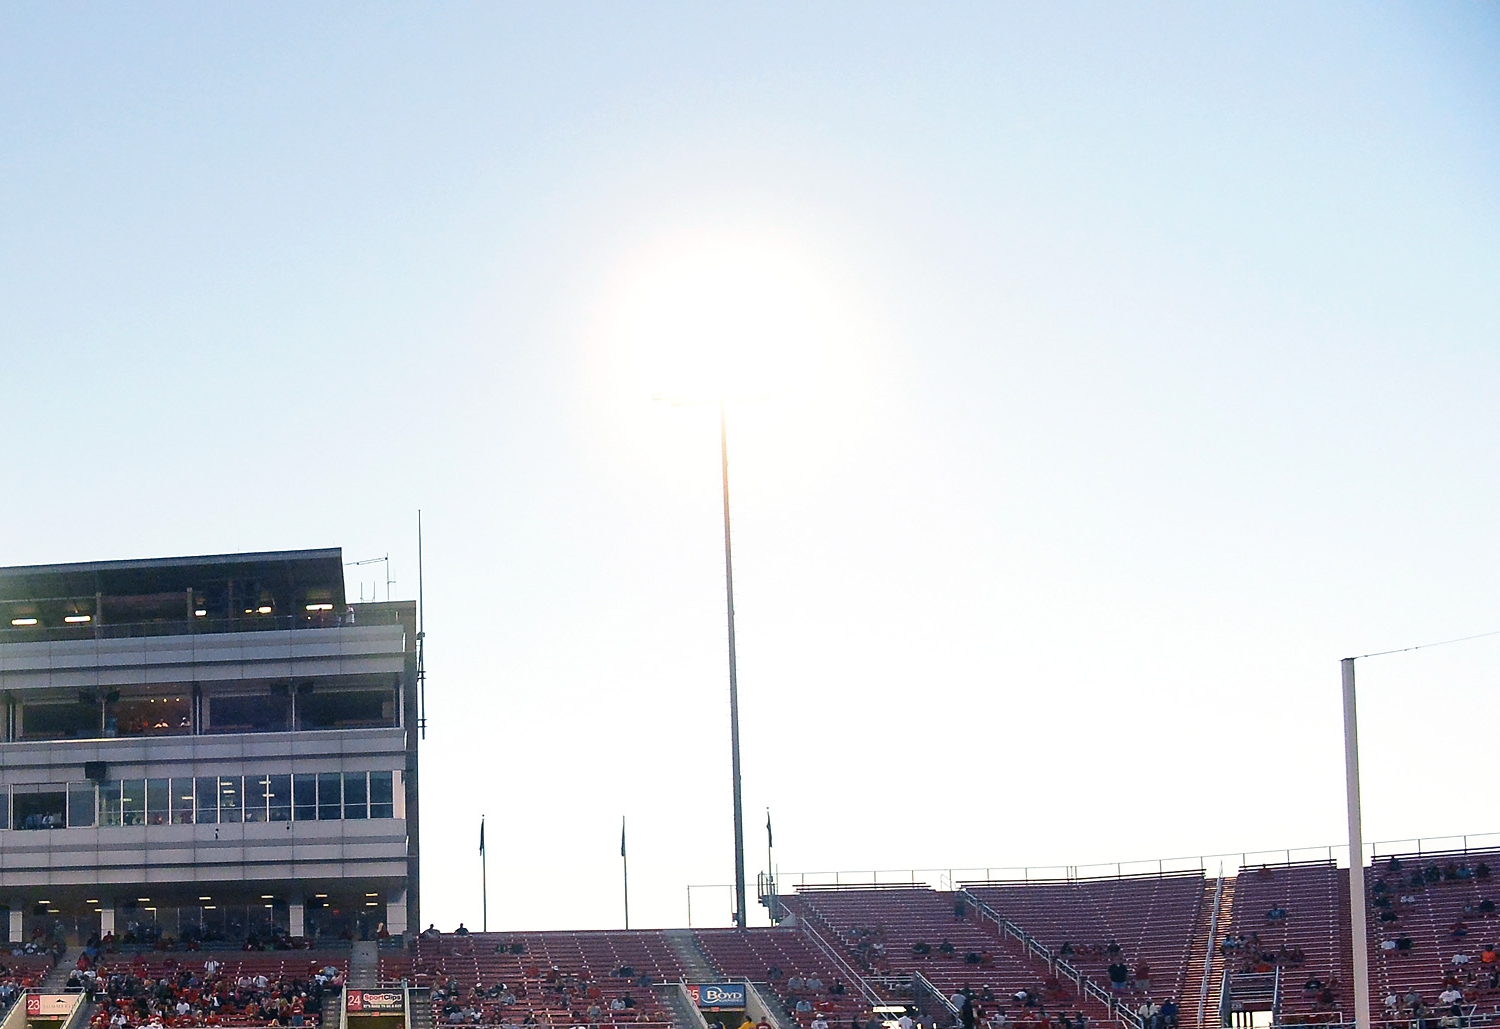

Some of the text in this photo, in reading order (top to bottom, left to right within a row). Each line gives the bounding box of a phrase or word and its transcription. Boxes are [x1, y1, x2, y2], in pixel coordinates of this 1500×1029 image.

[347, 995, 362, 1006] 24
[363, 993, 402, 1002] SportClips
[27, 999, 40, 1010] 23
